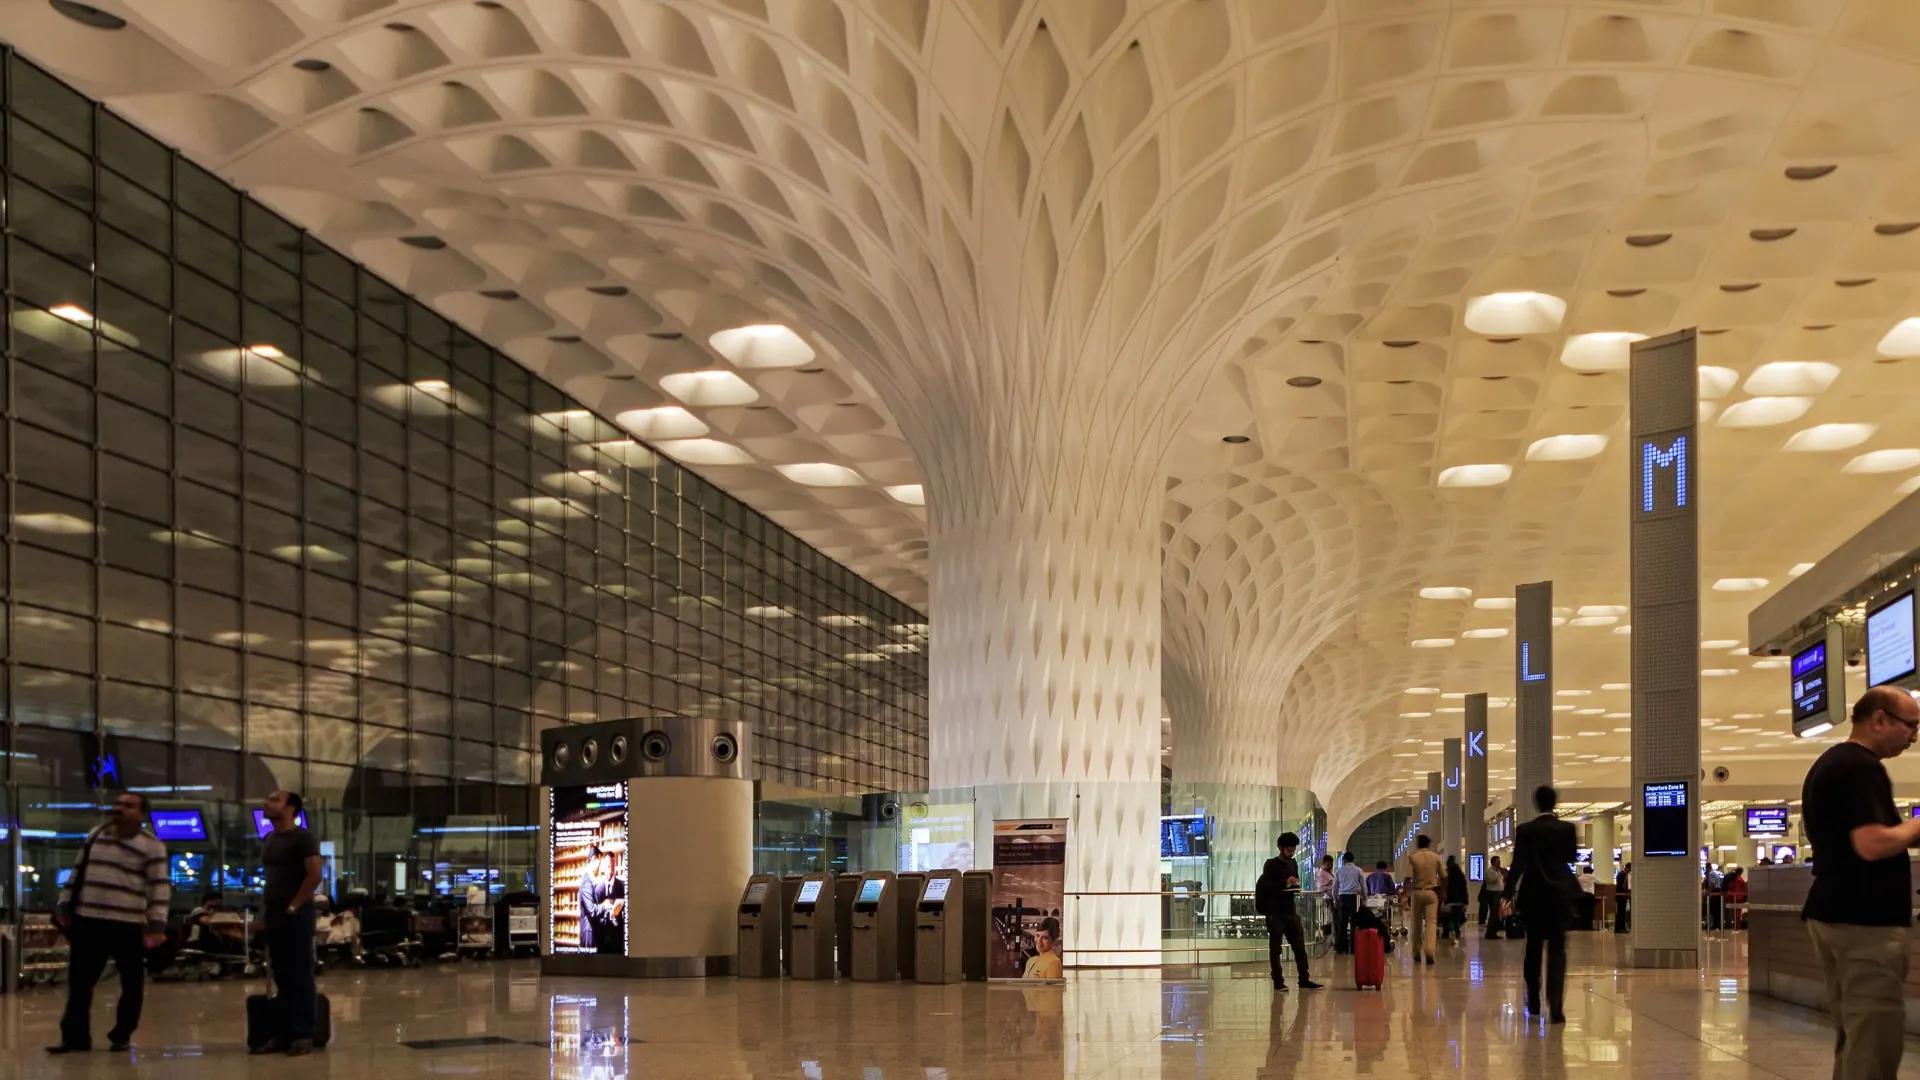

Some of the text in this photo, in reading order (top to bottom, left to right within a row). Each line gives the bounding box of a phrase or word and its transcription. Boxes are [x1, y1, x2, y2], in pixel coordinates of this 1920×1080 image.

[1643, 436, 1686, 512] M
[1522, 642, 1546, 681] L
[1468, 730, 1484, 757] K
[1446, 767, 1459, 788] J
[1430, 794, 1440, 811] H
[1421, 809, 1429, 823] G
[1408, 830, 1413, 841] E
[1413, 822, 1420, 834] F
